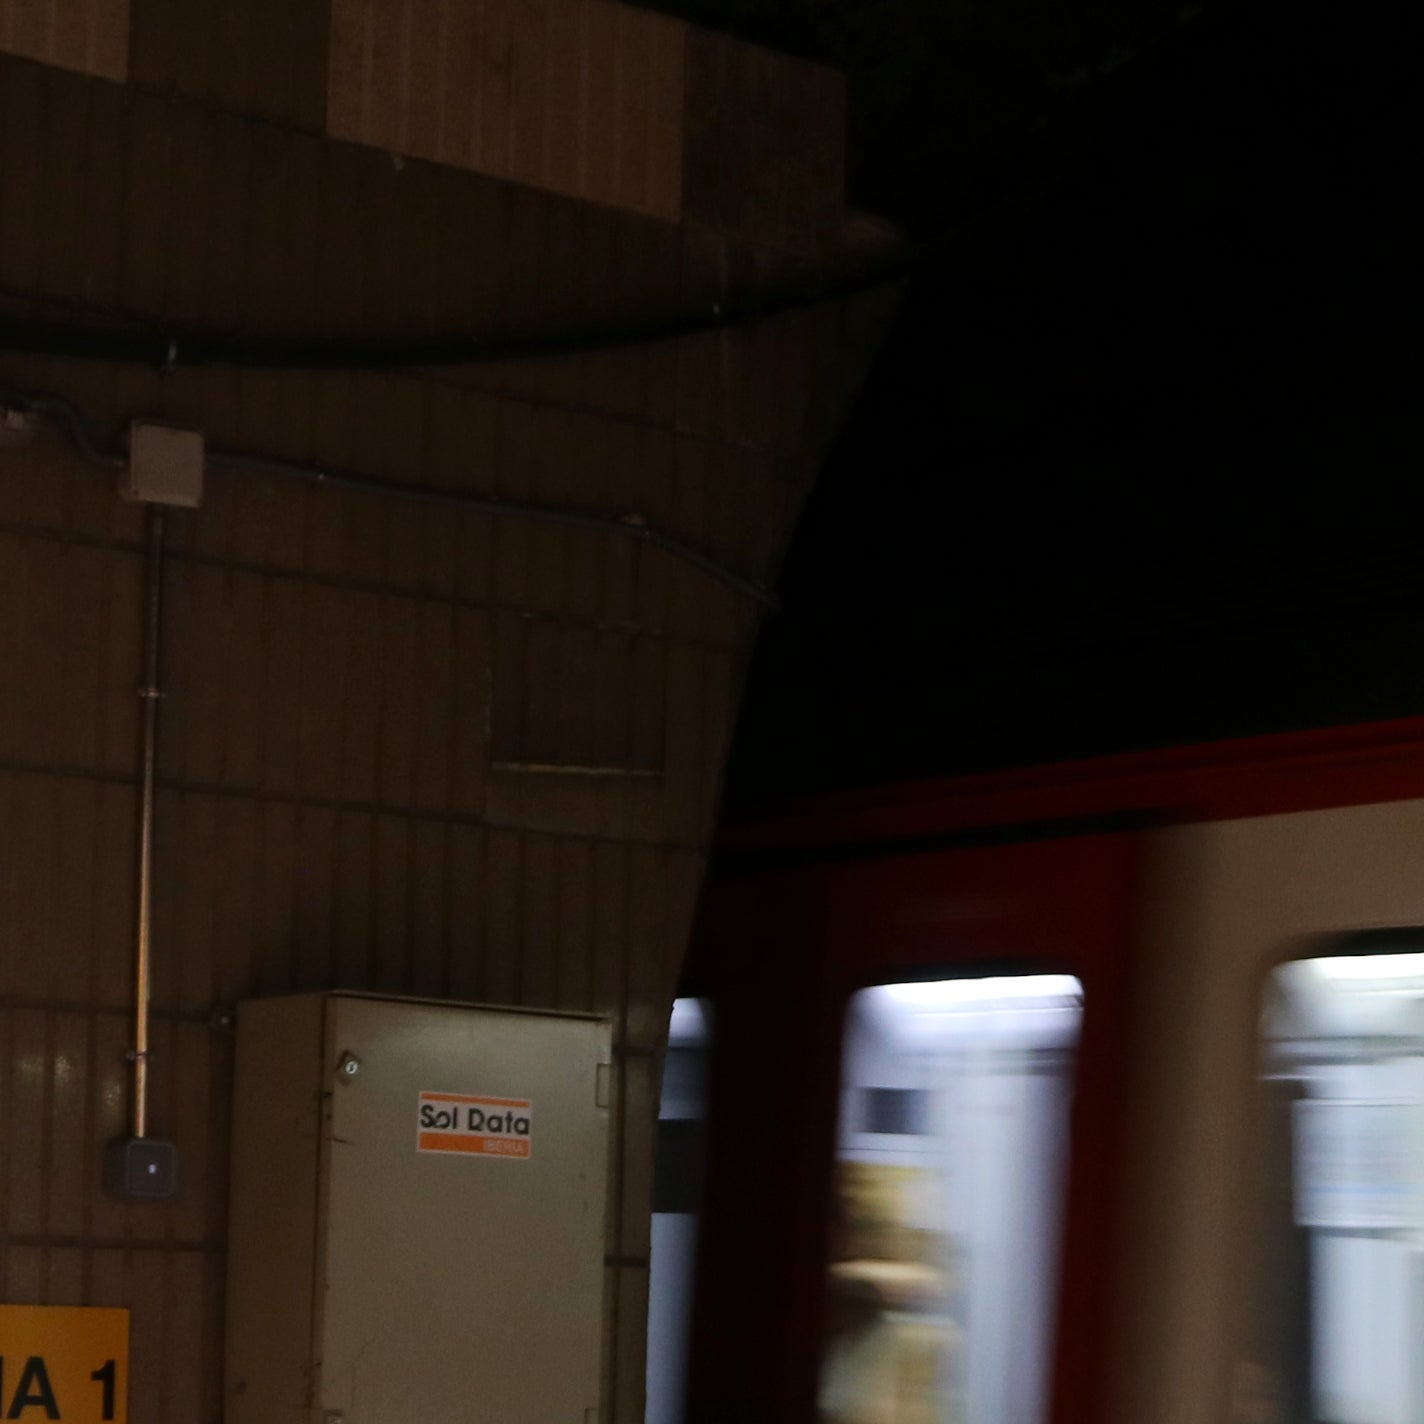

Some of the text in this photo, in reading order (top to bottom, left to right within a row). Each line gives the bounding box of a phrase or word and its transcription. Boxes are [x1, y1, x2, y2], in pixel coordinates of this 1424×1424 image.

[421, 1104, 529, 1135] Sol Data
[91, 1359, 116, 1421] 1
